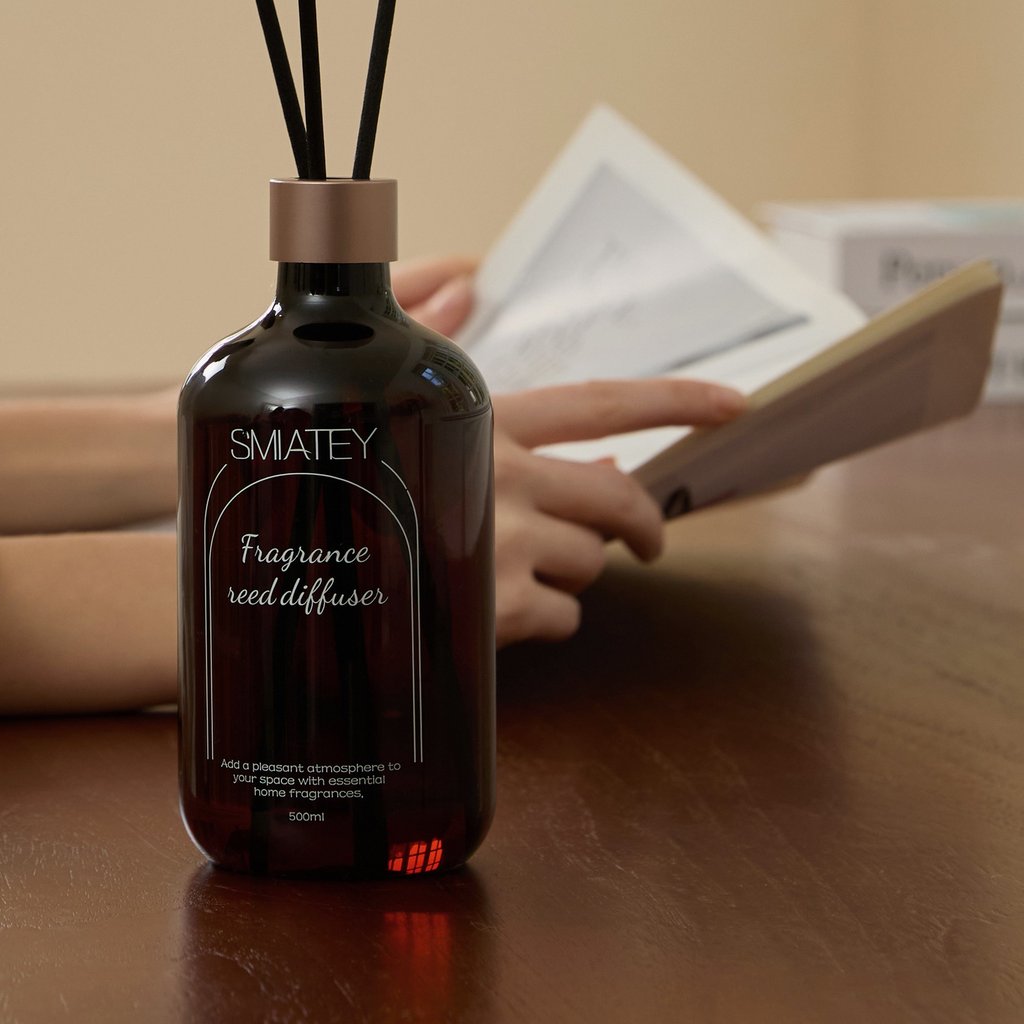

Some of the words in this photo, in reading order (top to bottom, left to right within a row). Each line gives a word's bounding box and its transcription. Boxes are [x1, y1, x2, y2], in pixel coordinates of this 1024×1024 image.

[241, 534, 370, 572] Fragrance
[228, 577, 278, 605] reed
[280, 577, 388, 615] diffuser
[220, 758, 240, 770] Add
[242, 762, 250, 771] a
[252, 762, 305, 773] pleasant
[306, 763, 385, 775] atmosphere
[387, 762, 402, 771] to
[232, 773, 258, 784] your
[259, 775, 296, 787] space
[297, 775, 325, 786] with
[328, 774, 386, 786] essential
[253, 786, 287, 798] home
[288, 811, 325, 822] 500ml
